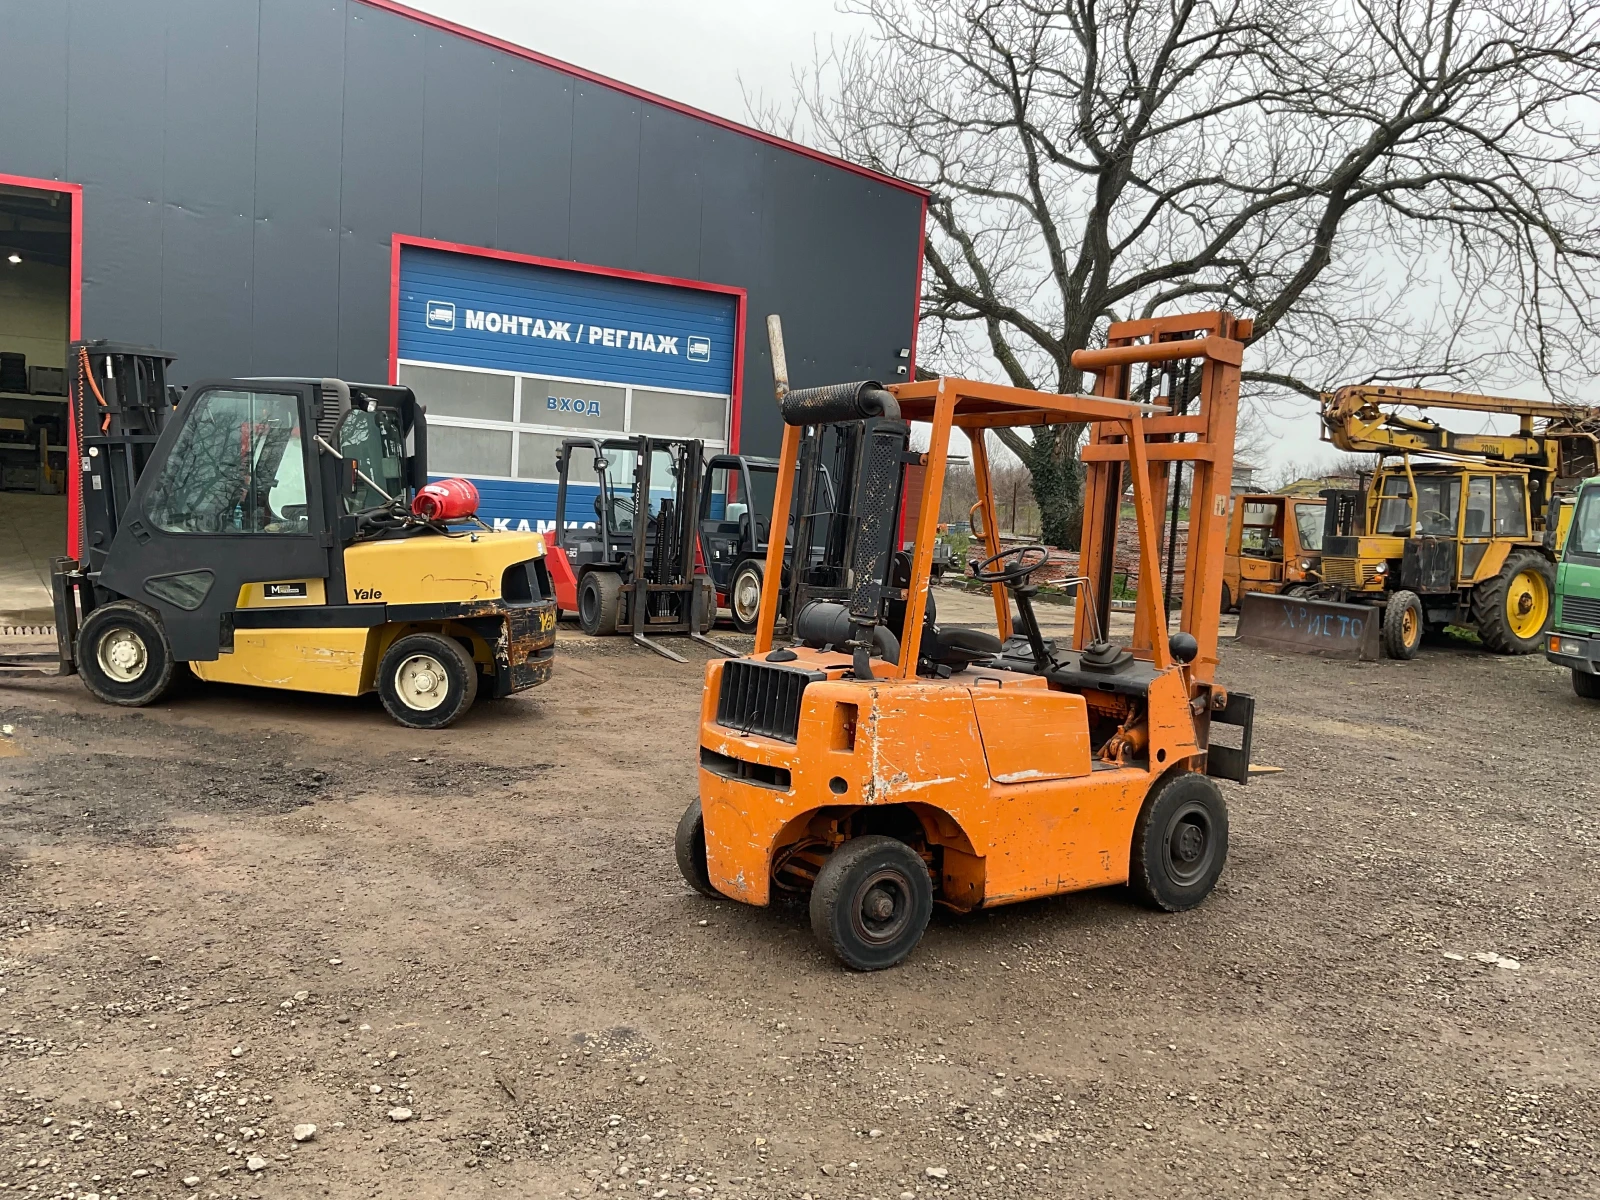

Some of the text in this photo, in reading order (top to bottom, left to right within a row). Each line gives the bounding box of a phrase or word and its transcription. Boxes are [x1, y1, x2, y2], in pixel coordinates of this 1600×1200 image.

[465, 309, 572, 342] МОНТАЖ
[588, 326, 680, 355] РЕГЛАЖ
[546, 396, 601, 416] ВХОД
[353, 588, 382, 600] Yale
[1281, 604, 1364, 639] ХРИСТО
